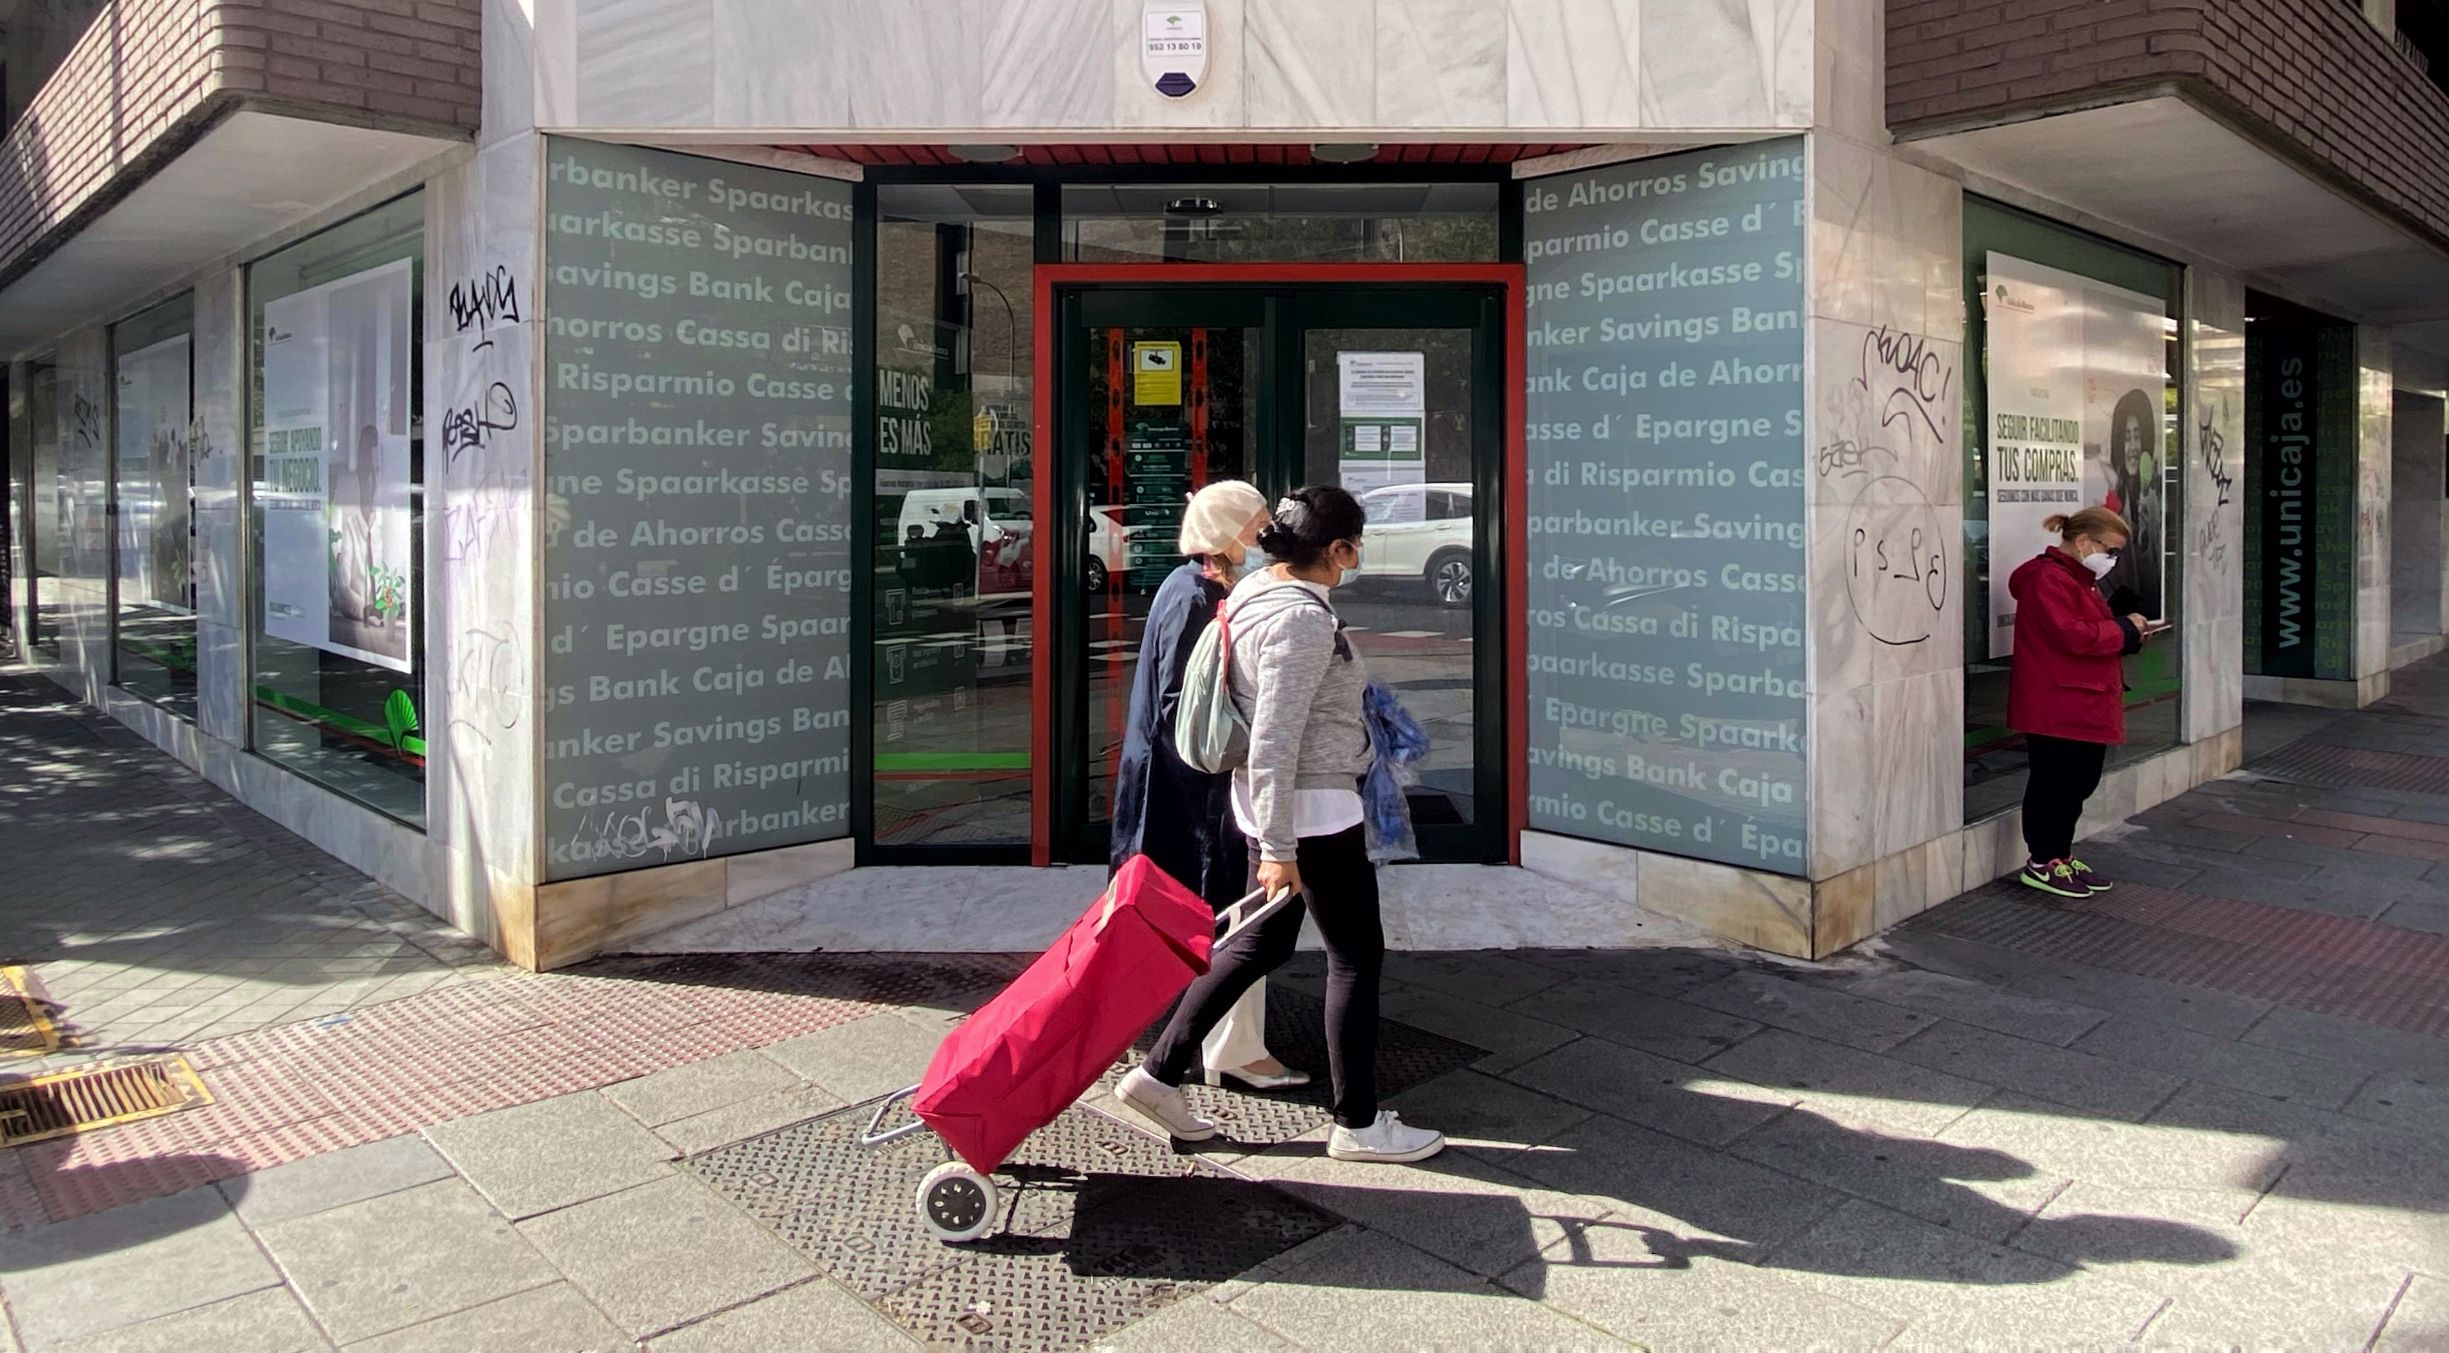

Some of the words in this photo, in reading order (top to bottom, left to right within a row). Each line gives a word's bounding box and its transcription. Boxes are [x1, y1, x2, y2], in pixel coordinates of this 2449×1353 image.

[1525, 188, 1559, 214] de
[1568, 172, 1687, 208] Ahorros
[713, 224, 853, 266] Sparban
[1640, 216, 1730, 245] Casse
[547, 262, 677, 299] avings
[689, 271, 774, 303] Bank
[785, 281, 851, 314] Caja
[1580, 262, 1763, 302] Spaarkasse
[676, 318, 771, 350] Cassa
[781, 327, 810, 352] di
[822, 330, 853, 356] Ri
[1527, 321, 1591, 347] nker
[1600, 313, 1720, 343] Savings
[557, 363, 736, 399] Risparmio
[747, 373, 834, 401] Casse
[879, 369, 929, 412] MENOS
[1582, 363, 1647, 396] Caja
[1658, 361, 1698, 388] de
[879, 416, 898, 454] ES
[901, 413, 932, 456] MÁS
[1636, 414, 1772, 445] Epargne
[1544, 461, 1570, 486] di
[1581, 460, 1736, 493] Risparmio
[1996, 445, 2020, 482] TUS
[2024, 447, 2080, 483] COMPRAS.
[616, 467, 810, 501] Spaarkasse
[2269, 355, 2311, 649] www.unicaja.es
[573, 520, 618, 549] de
[630, 519, 765, 547] Ahorros
[608, 571, 707, 597] Casse
[1543, 555, 1576, 581] de
[1587, 557, 1708, 588] Ahorros
[606, 622, 750, 657] Epargne
[1573, 605, 1658, 635] Cassa
[1670, 611, 1699, 639] di
[588, 669, 681, 702] Bank
[692, 664, 765, 696] Caja
[776, 658, 814, 685] de
[653, 715, 782, 749] Savings
[1545, 697, 1669, 738] Epargne
[1679, 712, 1807, 753] Spaark
[553, 778, 656, 810] Cassa
[669, 766, 700, 795] di
[713, 747, 850, 790] Risparmi
[1626, 754, 1707, 791] Bank
[1717, 767, 1793, 808] Caja
[1596, 799, 1682, 838] Casse
